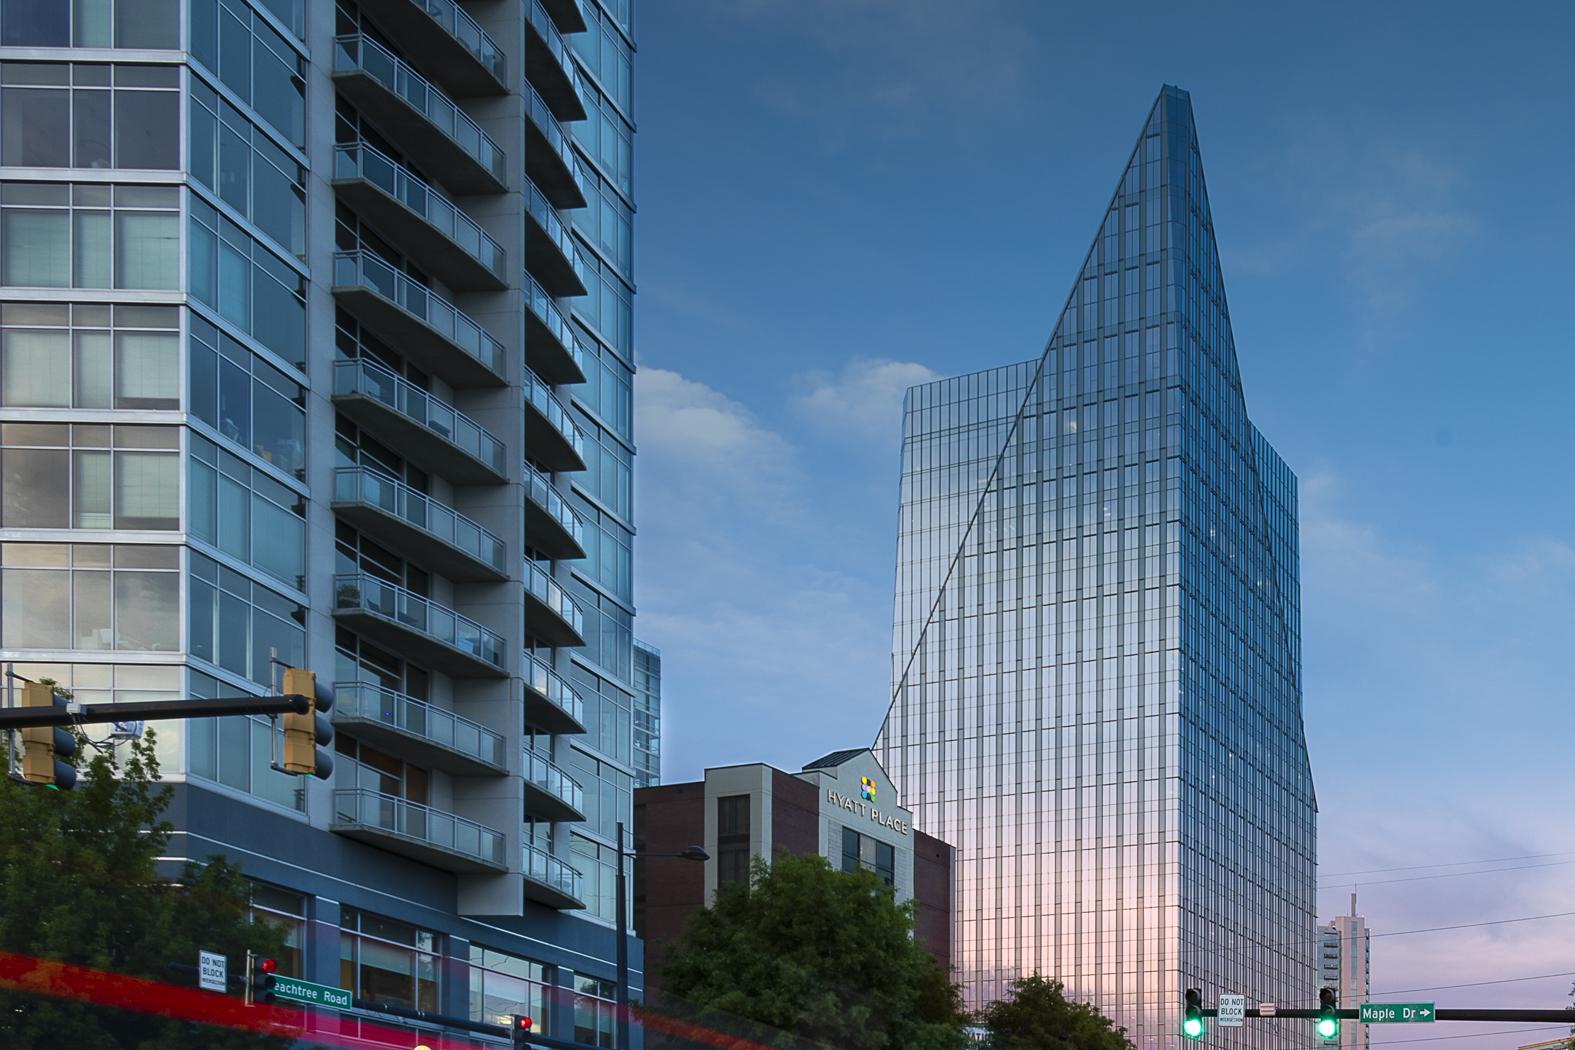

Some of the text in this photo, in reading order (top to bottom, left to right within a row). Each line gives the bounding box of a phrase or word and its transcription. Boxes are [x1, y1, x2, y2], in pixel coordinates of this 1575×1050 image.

[828, 789, 908, 834] HYATT PLACE
[202, 956, 225, 968] DO NOT
[203, 967, 224, 978] BLOCK
[274, 982, 347, 1005] eachtree Road
[1220, 998, 1243, 1006] DO NOT
[1220, 1008, 1242, 1016] BLOCK
[1363, 1007, 1416, 1020] Maple Dr
